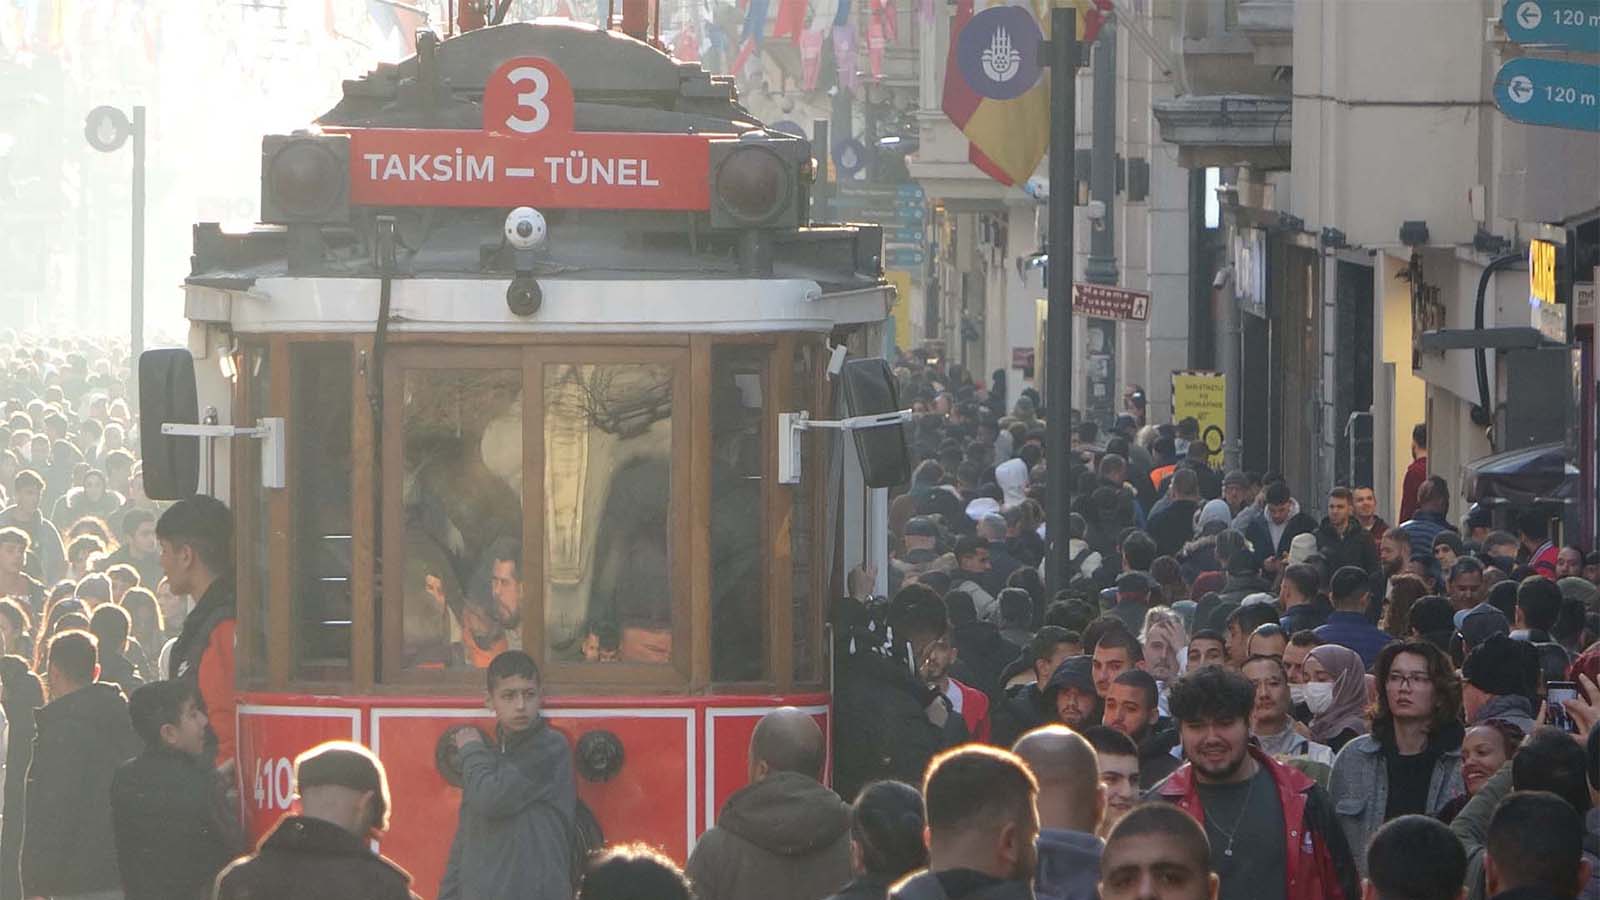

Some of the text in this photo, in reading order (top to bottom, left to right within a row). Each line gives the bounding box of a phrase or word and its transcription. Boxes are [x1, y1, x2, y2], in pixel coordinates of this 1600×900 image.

[1553, 9, 1584, 26] 120
[505, 66, 550, 134] 3
[1545, 86, 1596, 106] 120 m
[364, 147, 495, 182] TAKSİM
[544, 150, 660, 186] TÜNEL
[254, 757, 295, 810] 410
